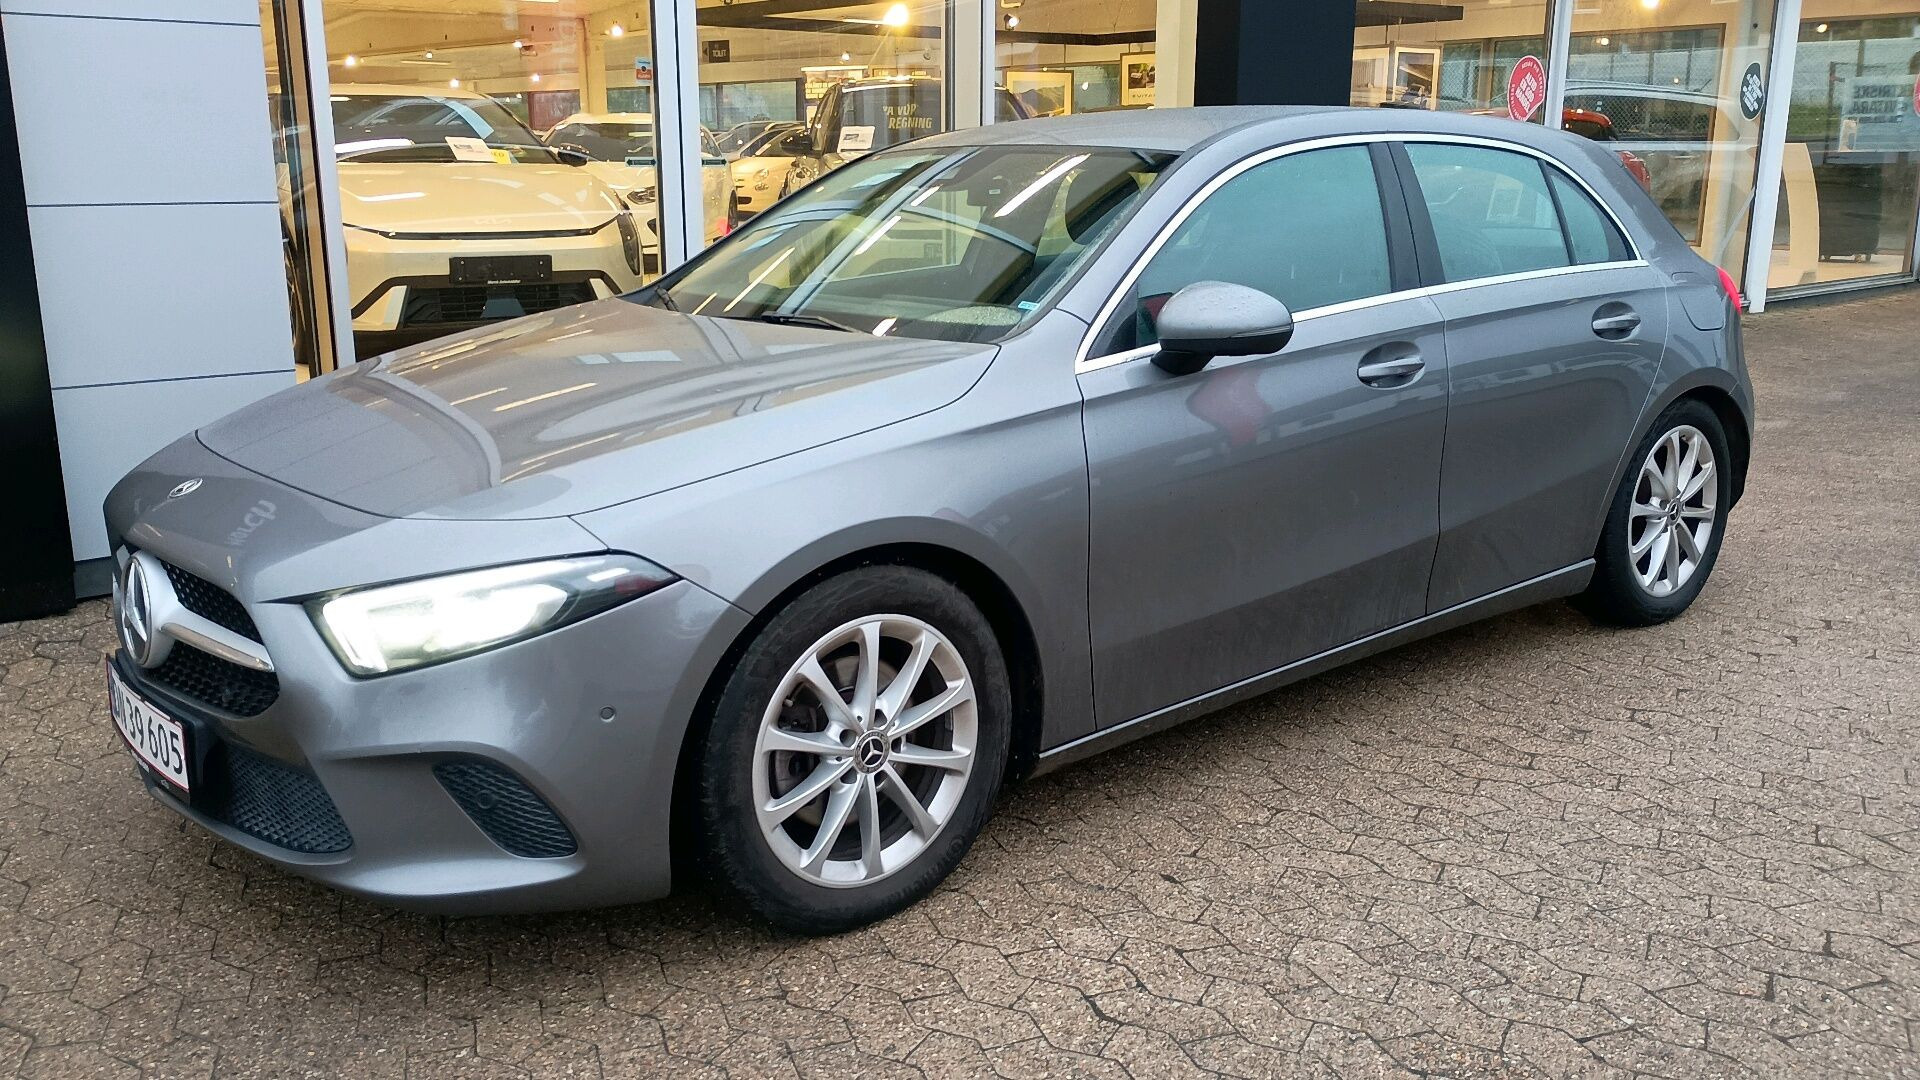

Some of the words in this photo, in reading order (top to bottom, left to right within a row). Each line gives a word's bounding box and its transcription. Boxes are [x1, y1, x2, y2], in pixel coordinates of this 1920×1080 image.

[1525, 86, 1535, 103] GOD
[888, 117, 932, 128] REGNING
[126, 696, 144, 749] 39
[148, 715, 183, 775] 605
